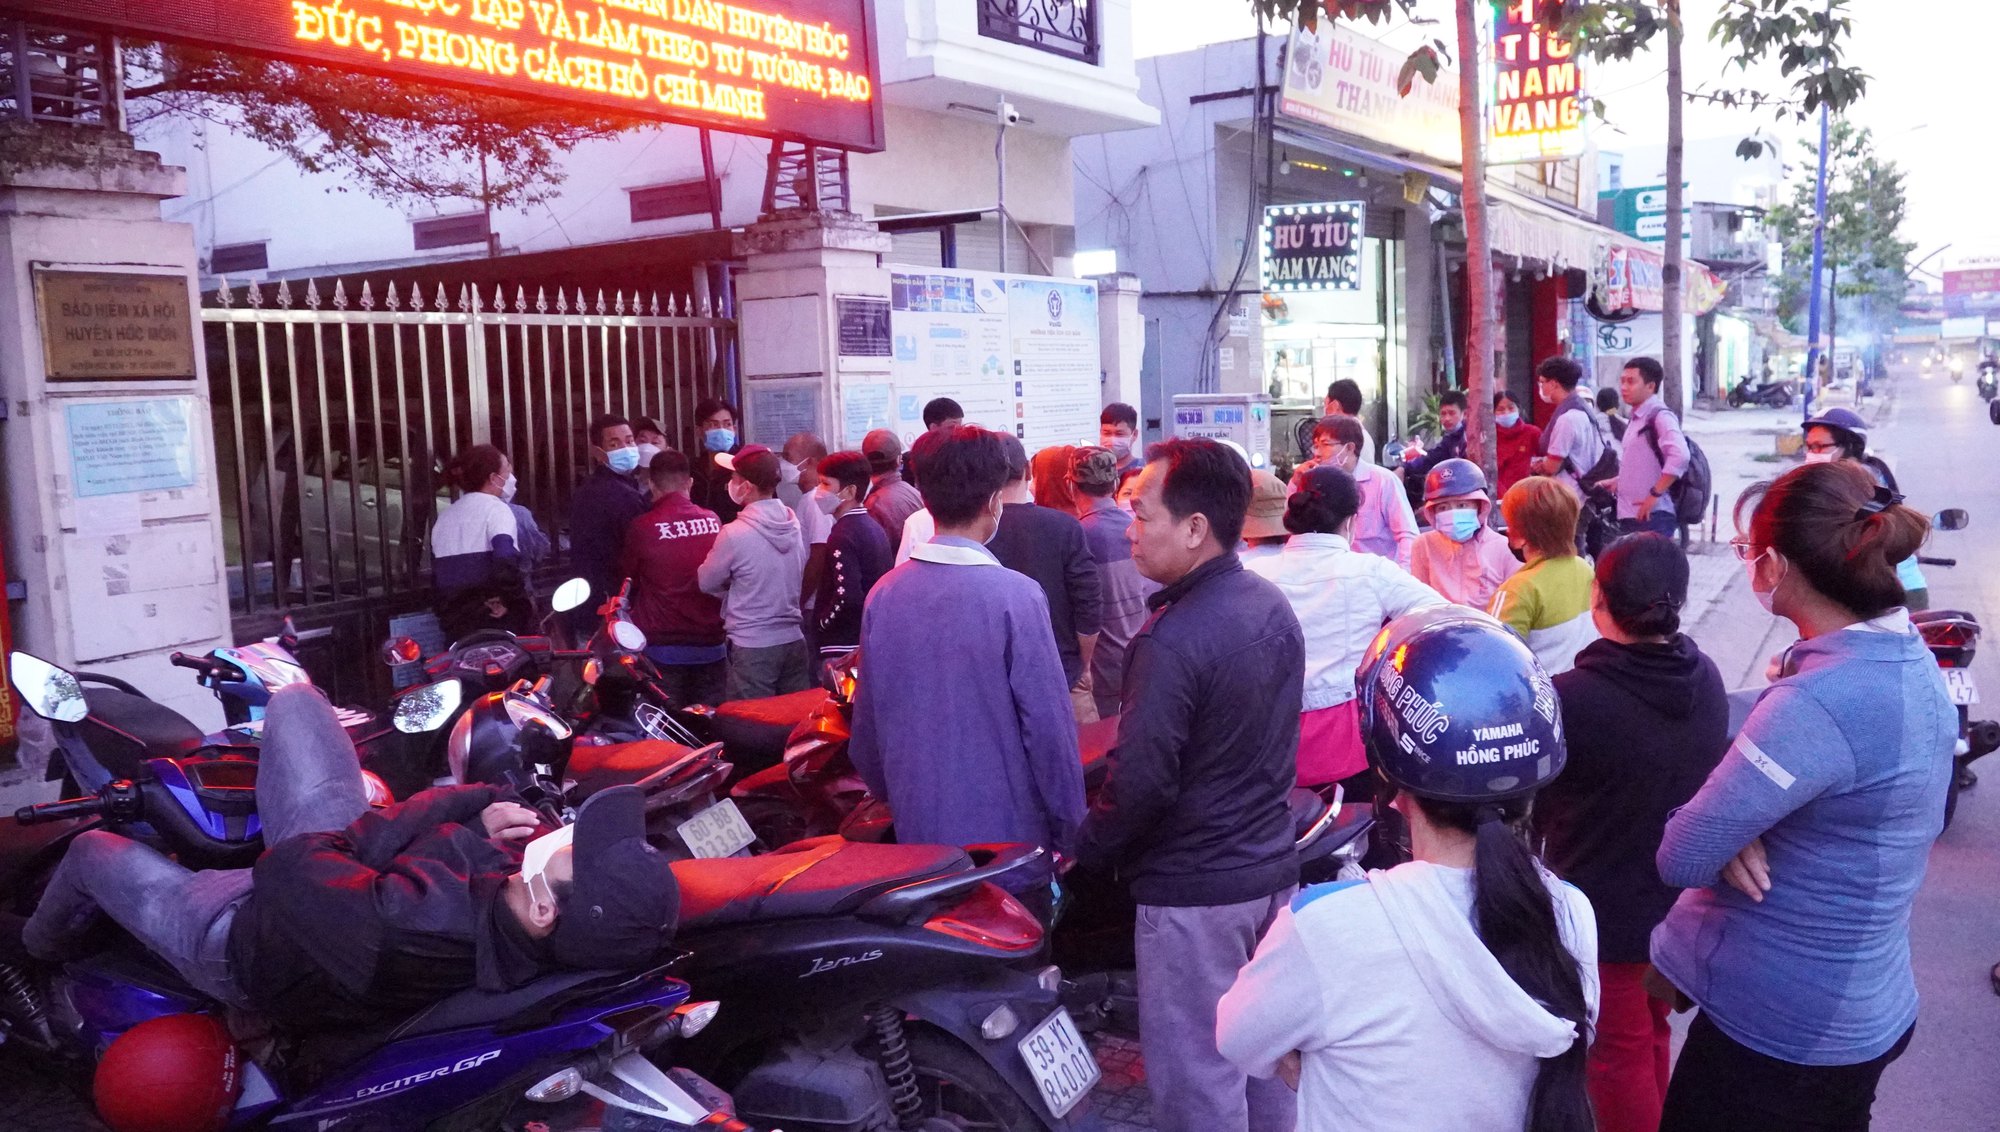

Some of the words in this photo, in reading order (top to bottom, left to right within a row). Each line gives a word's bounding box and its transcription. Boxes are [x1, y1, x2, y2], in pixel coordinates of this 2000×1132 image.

[575, 6, 643, 55] LÀM
[641, 25, 710, 69] THEO
[711, 42, 745, 76] TƯ
[827, 67, 871, 101] ĐẠO
[727, 5, 804, 51] HUYỆN
[805, 21, 849, 60] HÓC
[293, 0, 391, 61] ĐỨC,
[395, 20, 519, 75] PHONG
[522, 41, 607, 92] CÁCH
[606, 58, 649, 99] HỒ
[654, 69, 701, 108] CHÍ
[700, 79, 766, 120] MINH
[1359, 48, 1384, 83] TÍU
[1387, 62, 1423, 99] NM
[1498, 62, 1575, 101] NAM
[1495, 96, 1580, 133] VANG
[1273, 213, 1306, 249] HỦ
[1310, 215, 1349, 248] TÍU
[1269, 257, 1304, 280] NAM
[1306, 254, 1353, 279] VANG
[1395, 684, 1450, 745] PHÚC
[1472, 722, 1524, 742] YAMAHA
[1456, 733, 1500, 766] HỒNG
[1503, 739, 1540, 761] PHÚC
[798, 949, 883, 978] Janus
[1028, 1018, 1073, 1071] 59-X1
[356, 1066, 450, 1098] EXCITER
[452, 1049, 502, 1073] GP
[1043, 1046, 1095, 1112] 840.01
